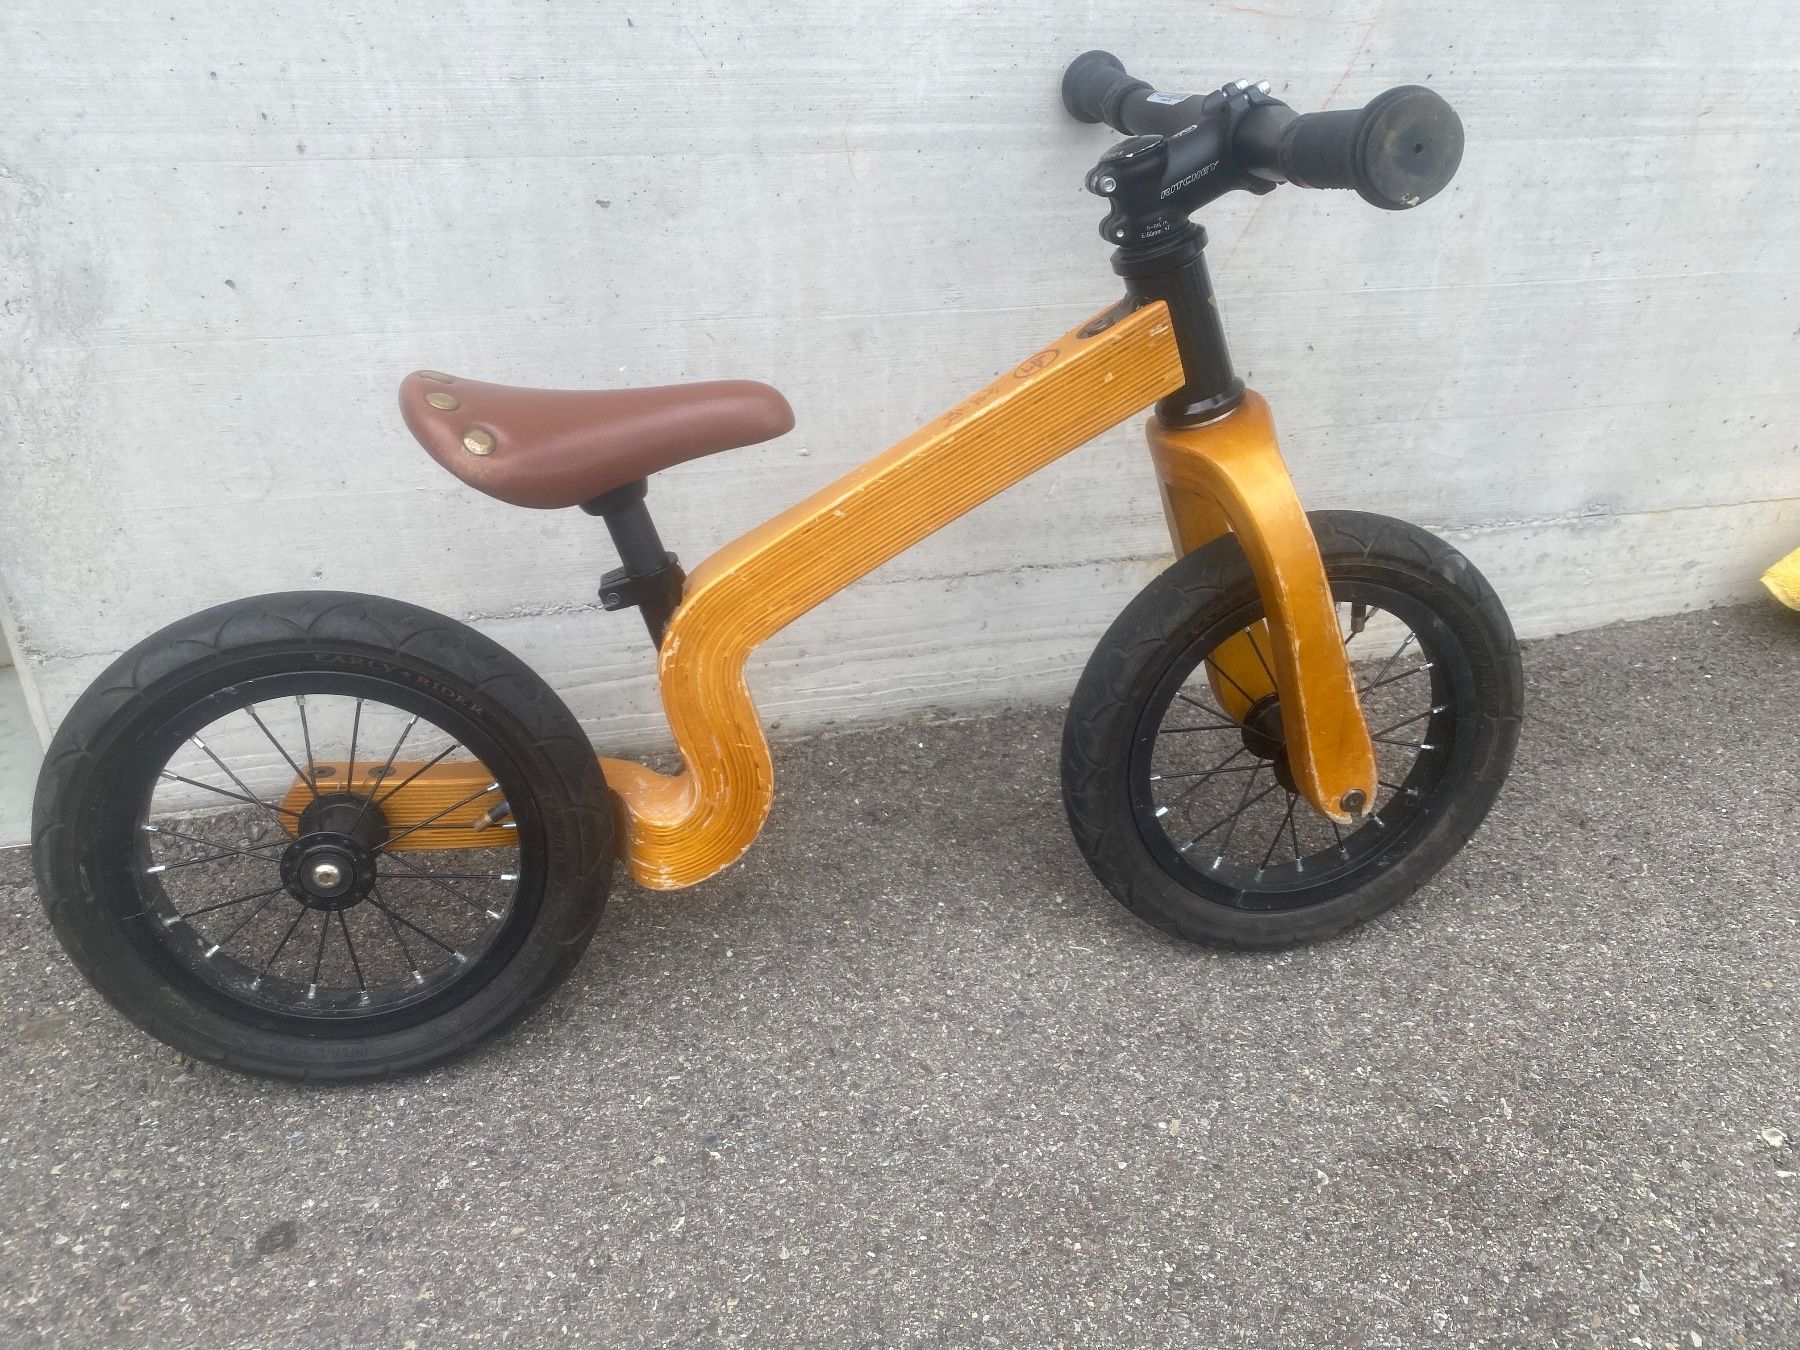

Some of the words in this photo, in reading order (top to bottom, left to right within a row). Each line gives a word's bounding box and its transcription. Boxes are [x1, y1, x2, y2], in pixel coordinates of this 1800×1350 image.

[1160, 159, 1220, 200] RITCHEY
[313, 652, 395, 673] EARLY
[416, 675, 484, 716] RIDER
